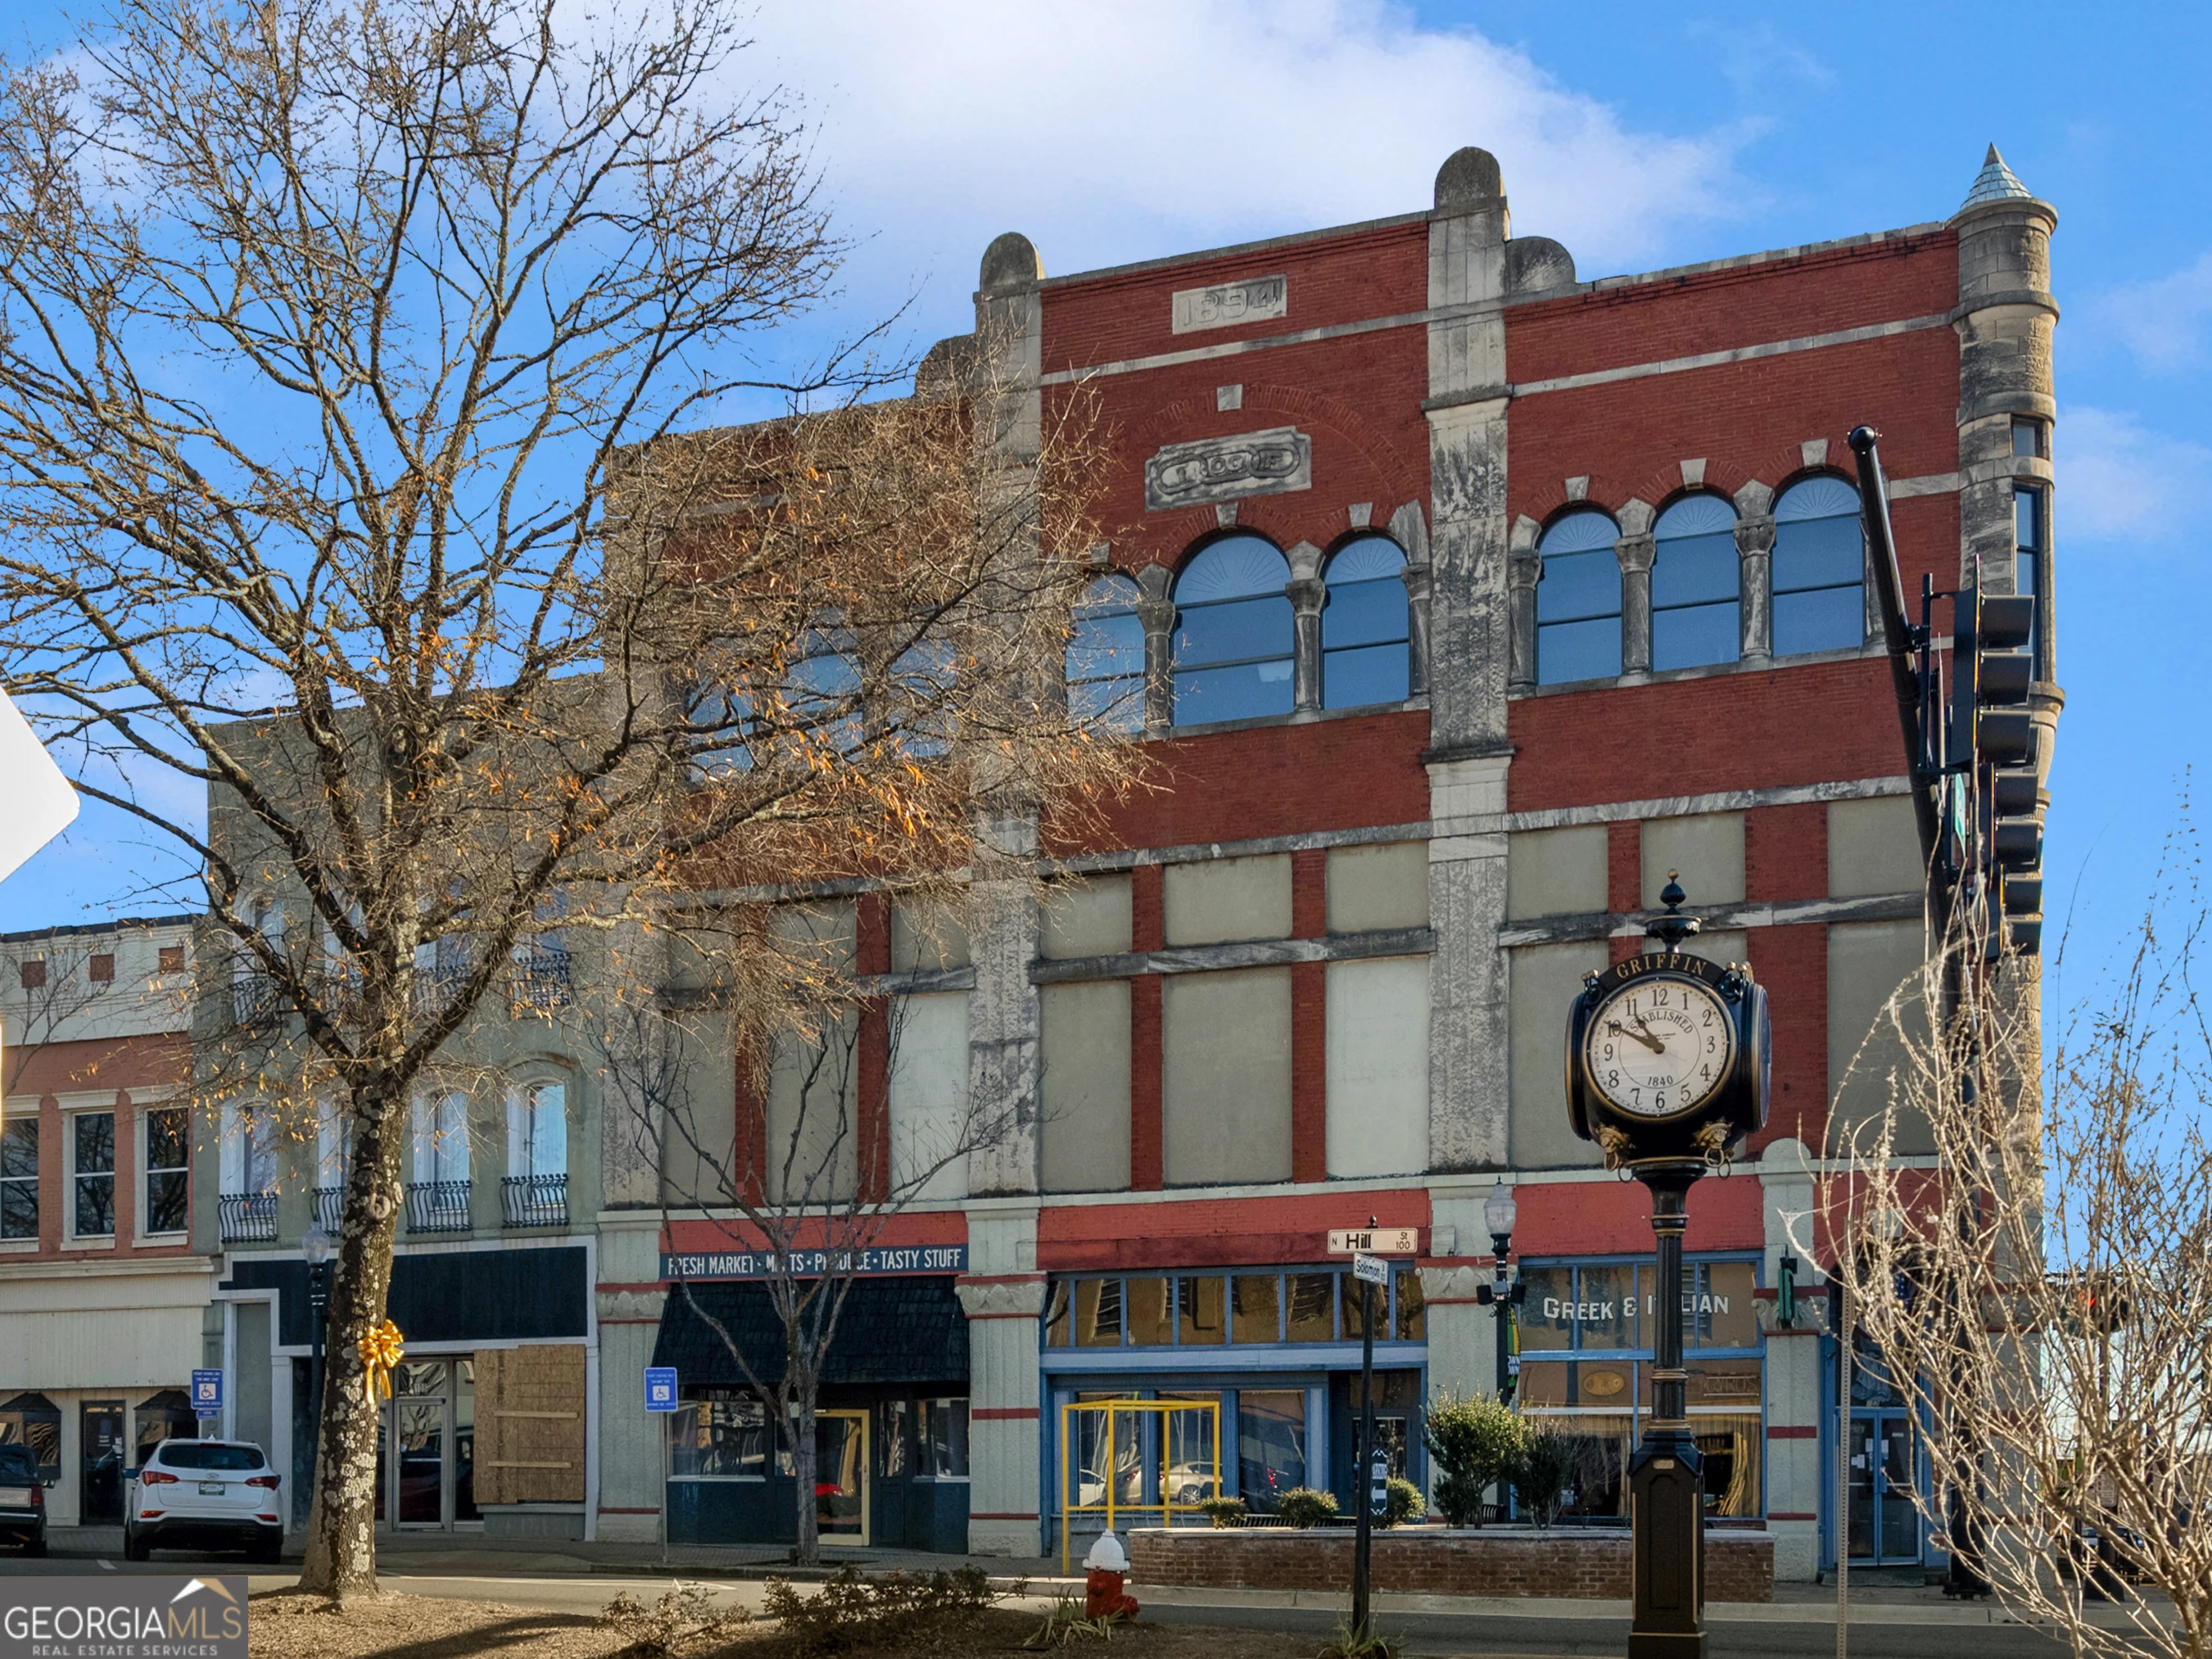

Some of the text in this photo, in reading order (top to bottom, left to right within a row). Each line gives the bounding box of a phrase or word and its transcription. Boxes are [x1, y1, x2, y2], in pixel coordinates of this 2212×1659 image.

[1183, 282, 1282, 326] 1894
[1617, 953, 1708, 979] GRIFFIN
[1652, 988, 1669, 1006] 12
[1681, 992, 1690, 1010] 1
[1626, 998, 1638, 1016] 11
[1702, 1009, 1713, 1028] 2
[1607, 1019, 1622, 1037] 10
[1604, 1043, 1613, 1061] 9
[1706, 1035, 1716, 1054] 3
[1608, 1069, 1619, 1088] 8
[1648, 1074, 1673, 1087] 1840
[1699, 1063, 1711, 1082] 4
[1630, 1088, 1644, 1105] 7
[1655, 1091, 1665, 1109] 6
[1680, 1083, 1691, 1102] 5
[1332, 1232, 1408, 1250] N Hill St
[1396, 1241, 1410, 1250] 100
[668, 1257, 705, 1276] FRESH
[709, 1255, 753, 1274] MARKET
[767, 1254, 804, 1273] MTS
[880, 1250, 920, 1269] TASTY
[924, 1249, 962, 1268] STUFF
[1356, 1259, 1380, 1277] Solomon
[1543, 1295, 1729, 1321] GREEK & ILIAN
